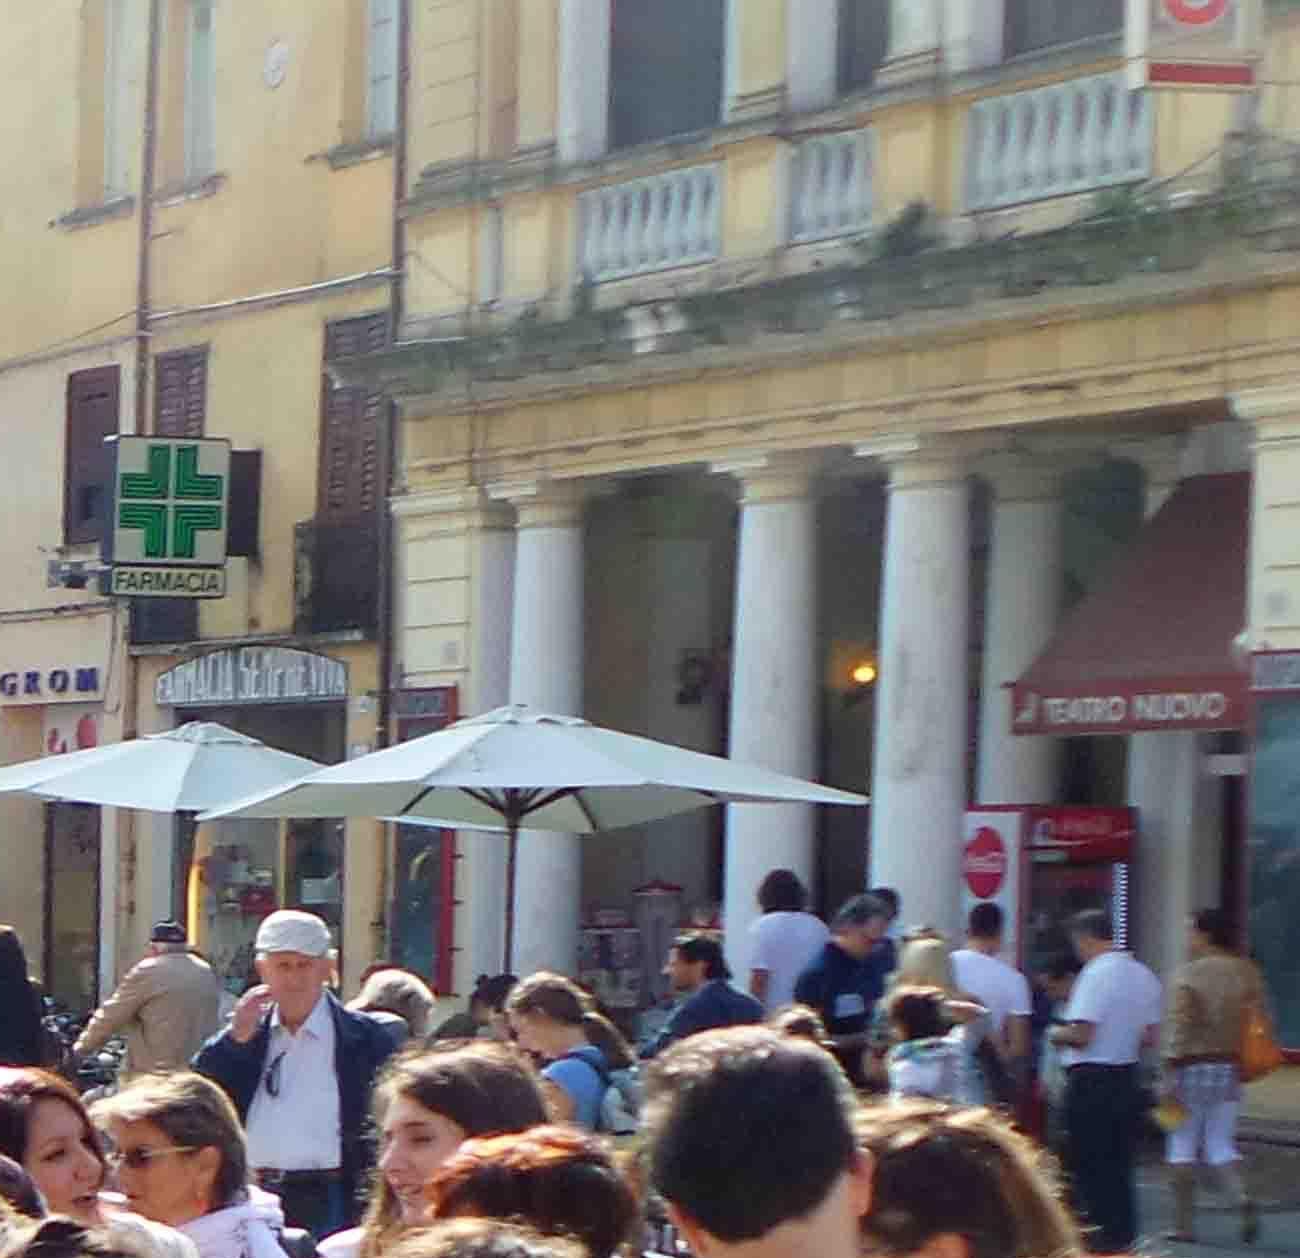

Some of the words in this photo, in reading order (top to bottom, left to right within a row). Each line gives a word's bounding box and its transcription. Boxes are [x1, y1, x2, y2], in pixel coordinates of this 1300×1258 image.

[115, 571, 219, 592] FARMACIA
[0, 668, 98, 695] GROM
[1043, 697, 1127, 723] TEATRO
[1135, 692, 1225, 720] NUOVO
